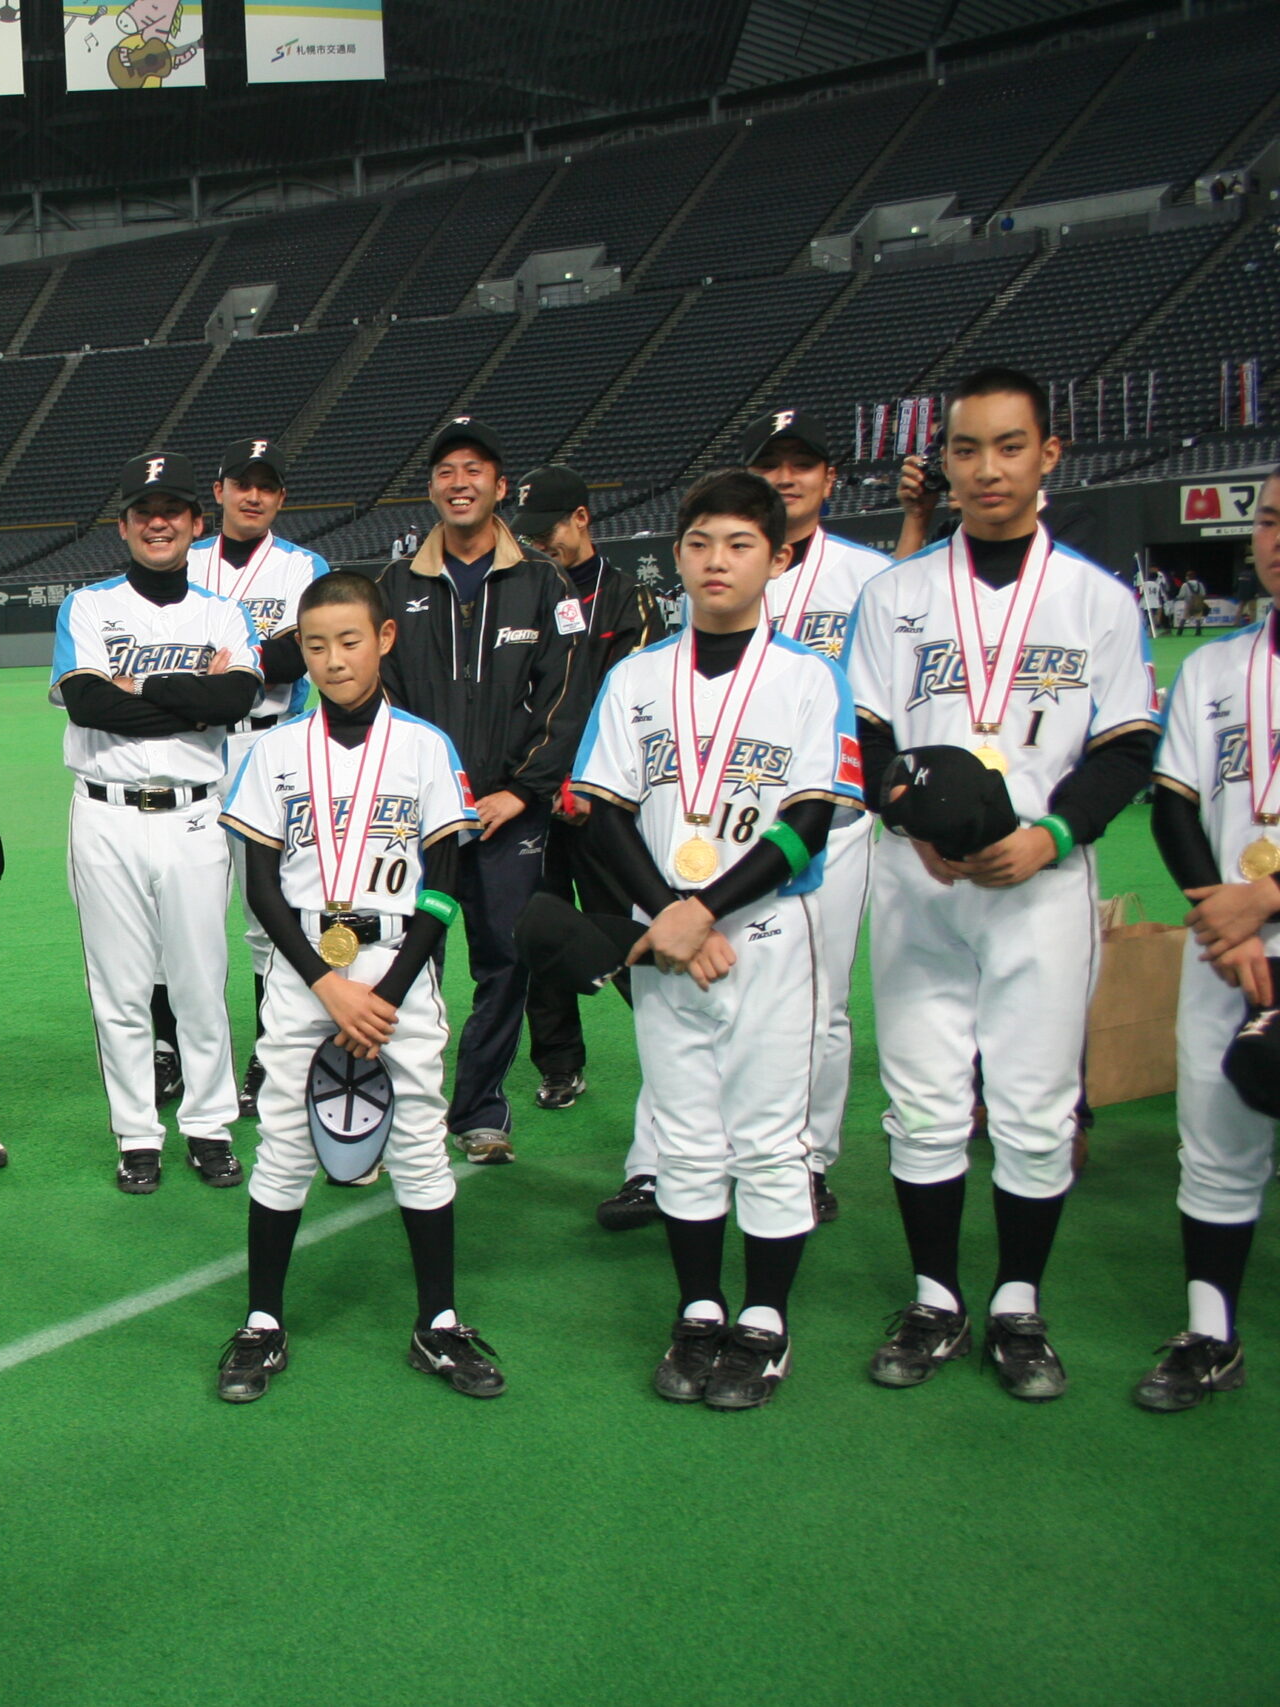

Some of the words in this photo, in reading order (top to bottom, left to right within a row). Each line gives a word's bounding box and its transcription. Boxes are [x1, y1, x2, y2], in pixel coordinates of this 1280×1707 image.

[249, 440, 268, 459] F
[144, 457, 166, 484] F
[1229, 485, 1256, 517] マ
[1022, 709, 1045, 749] 1
[713, 801, 761, 846] 18
[365, 856, 410, 896] 10
